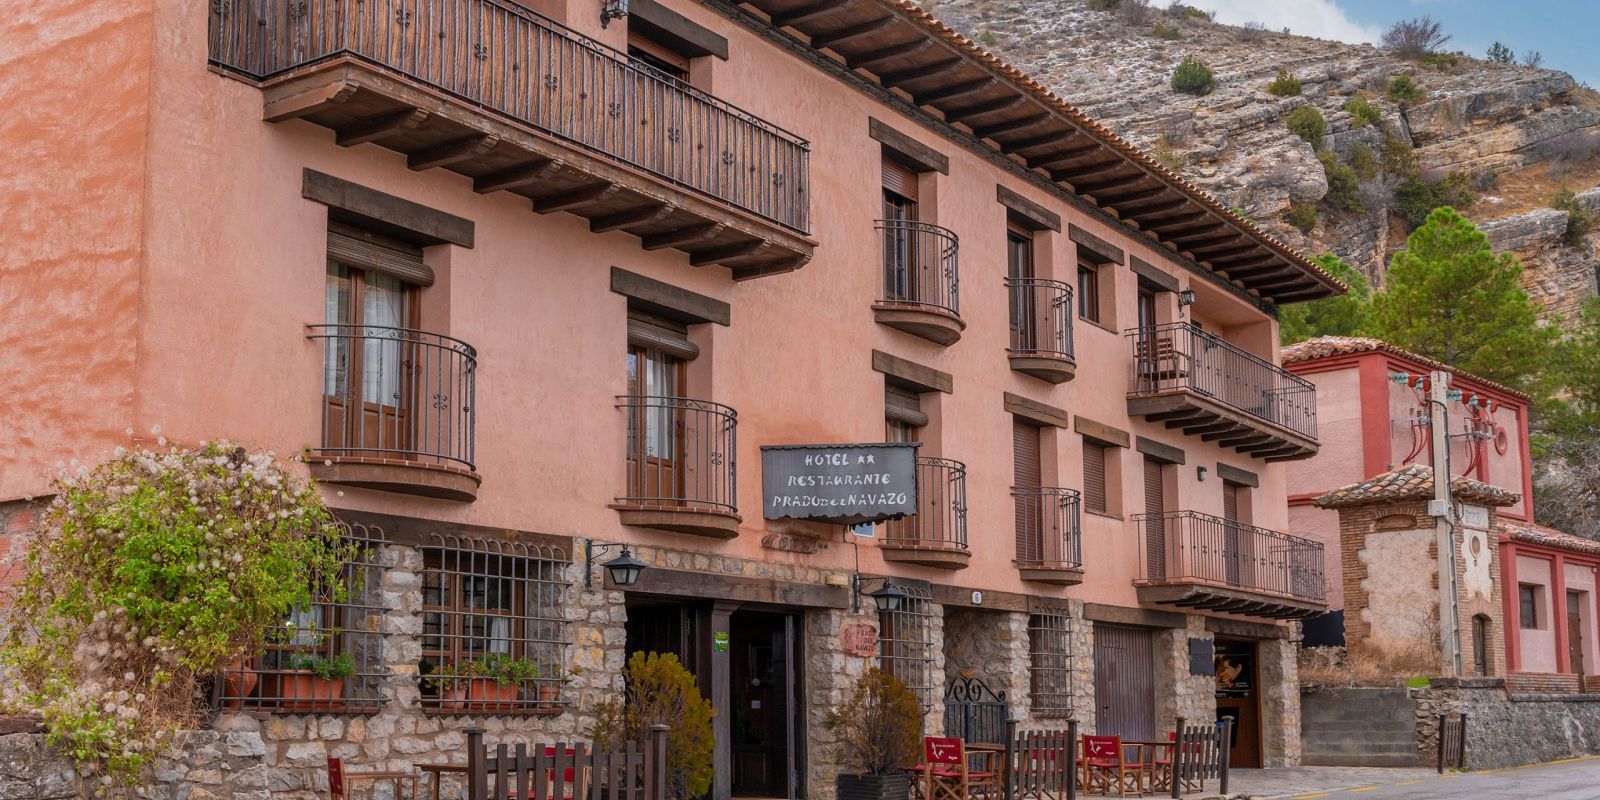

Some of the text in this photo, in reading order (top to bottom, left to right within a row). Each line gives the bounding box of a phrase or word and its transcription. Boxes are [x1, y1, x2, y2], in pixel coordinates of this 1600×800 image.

[804, 453, 850, 466] HOTEL
[788, 473, 891, 486] RESTAURANTE
[772, 495, 820, 507] PRADO
[847, 492, 907, 506] NAVAZO
